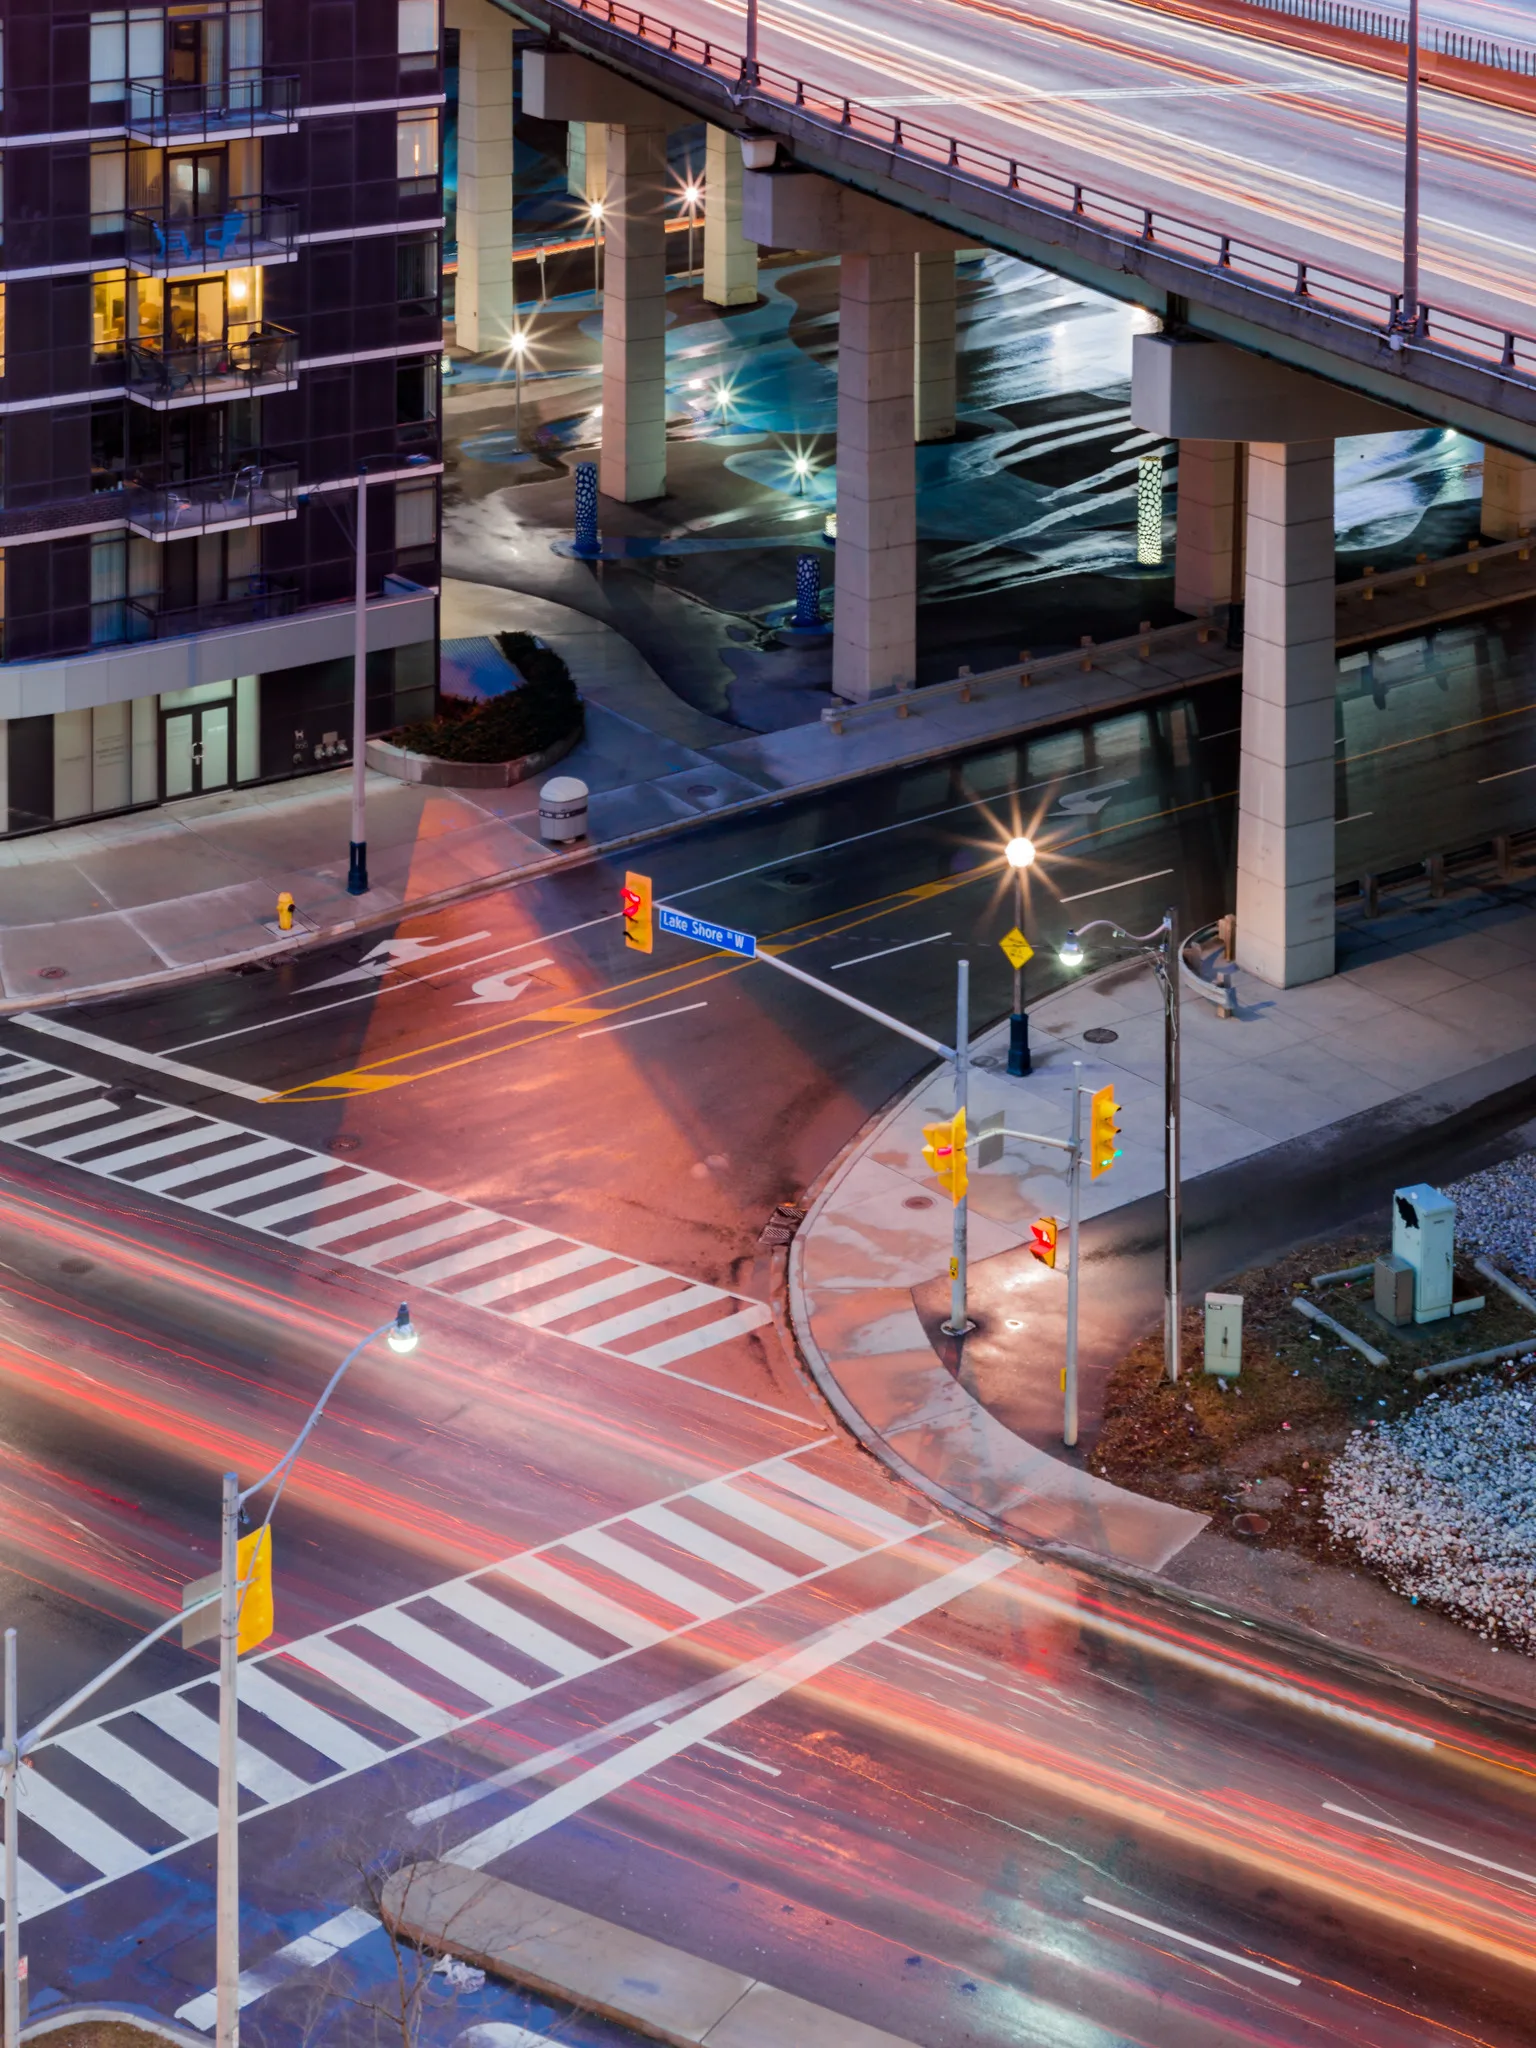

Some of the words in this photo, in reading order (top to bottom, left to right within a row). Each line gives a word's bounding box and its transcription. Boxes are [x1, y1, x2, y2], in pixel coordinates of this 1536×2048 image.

[663, 912, 688, 932] Lake
[692, 921, 723, 942] Shore
[734, 933, 745, 949] W
